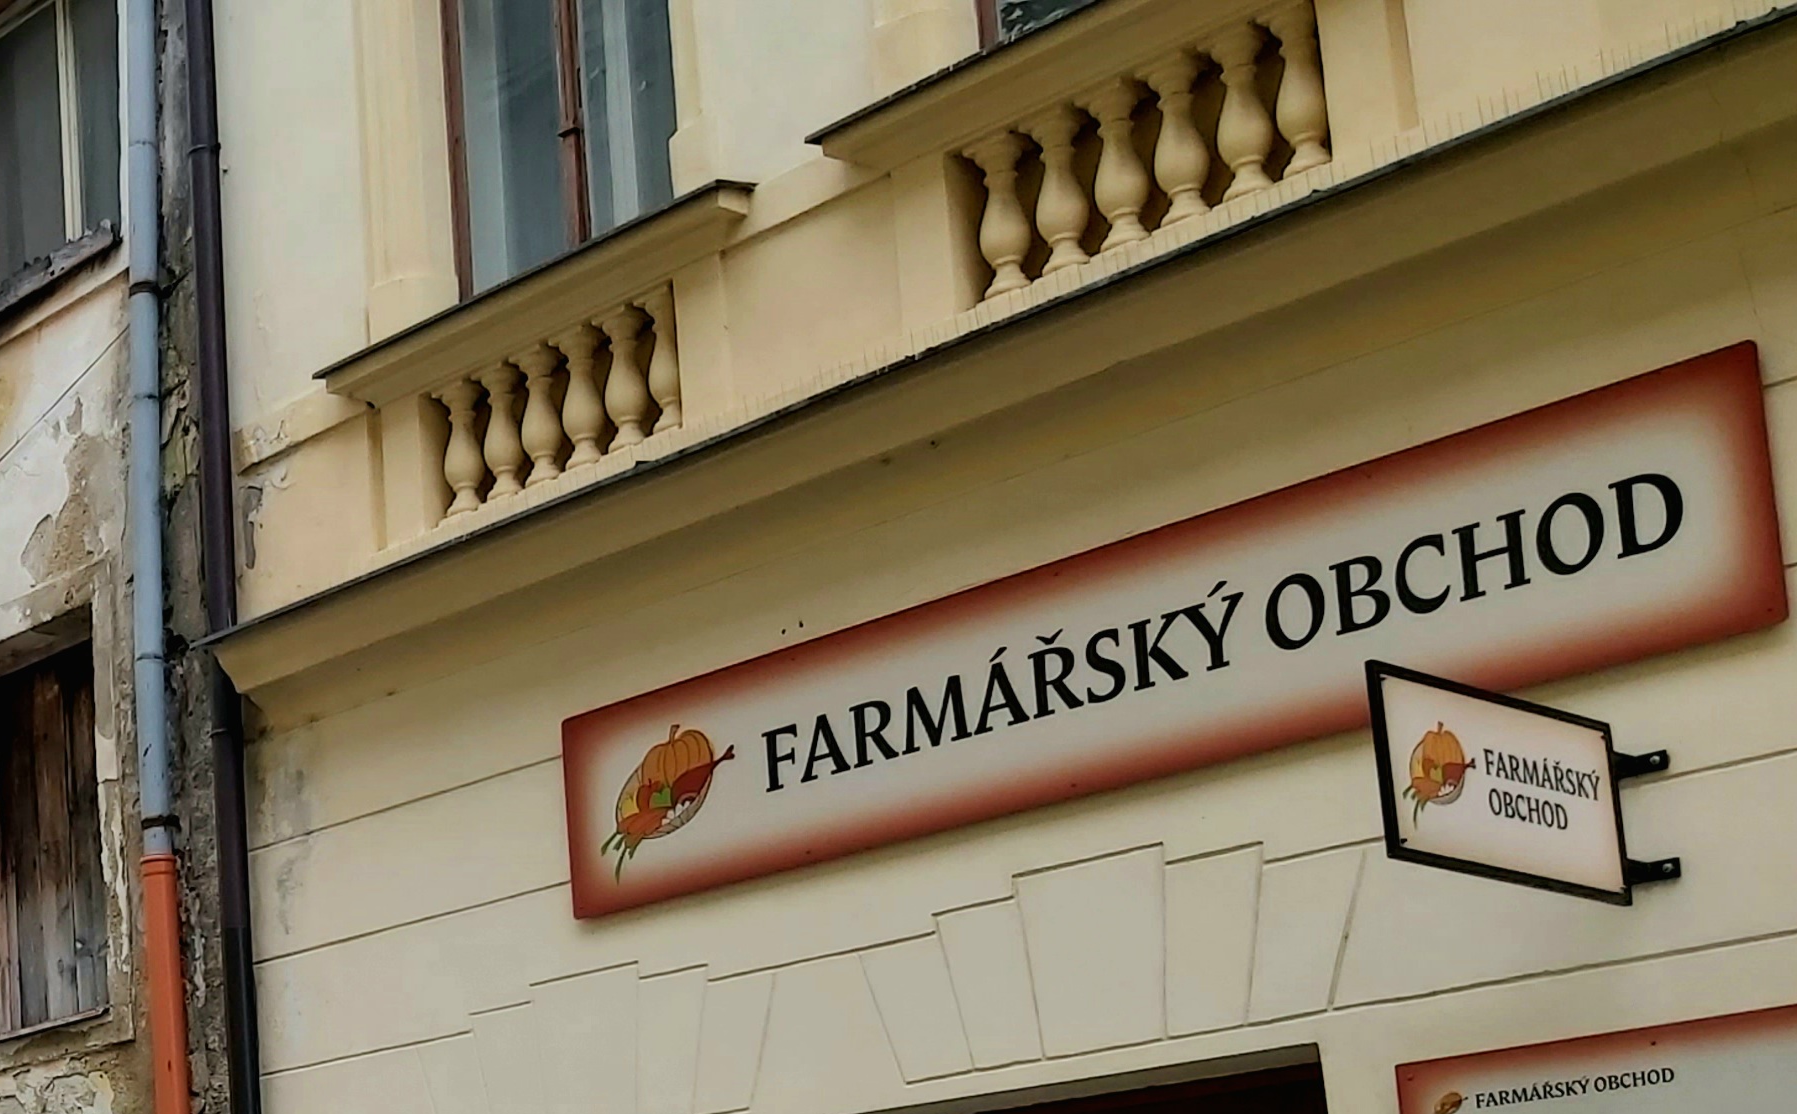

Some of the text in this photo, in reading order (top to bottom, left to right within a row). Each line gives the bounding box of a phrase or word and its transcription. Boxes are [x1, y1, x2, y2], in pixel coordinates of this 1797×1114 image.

[761, 473, 1684, 793] FARMÁŘSKÝ OBCHOD
[1482, 747, 1601, 802] FARMÁŘSKÝ
[1488, 788, 1569, 831] OBCHOD
[1475, 1066, 1676, 1109] FARMÁŘSKÝ OBCHOD
